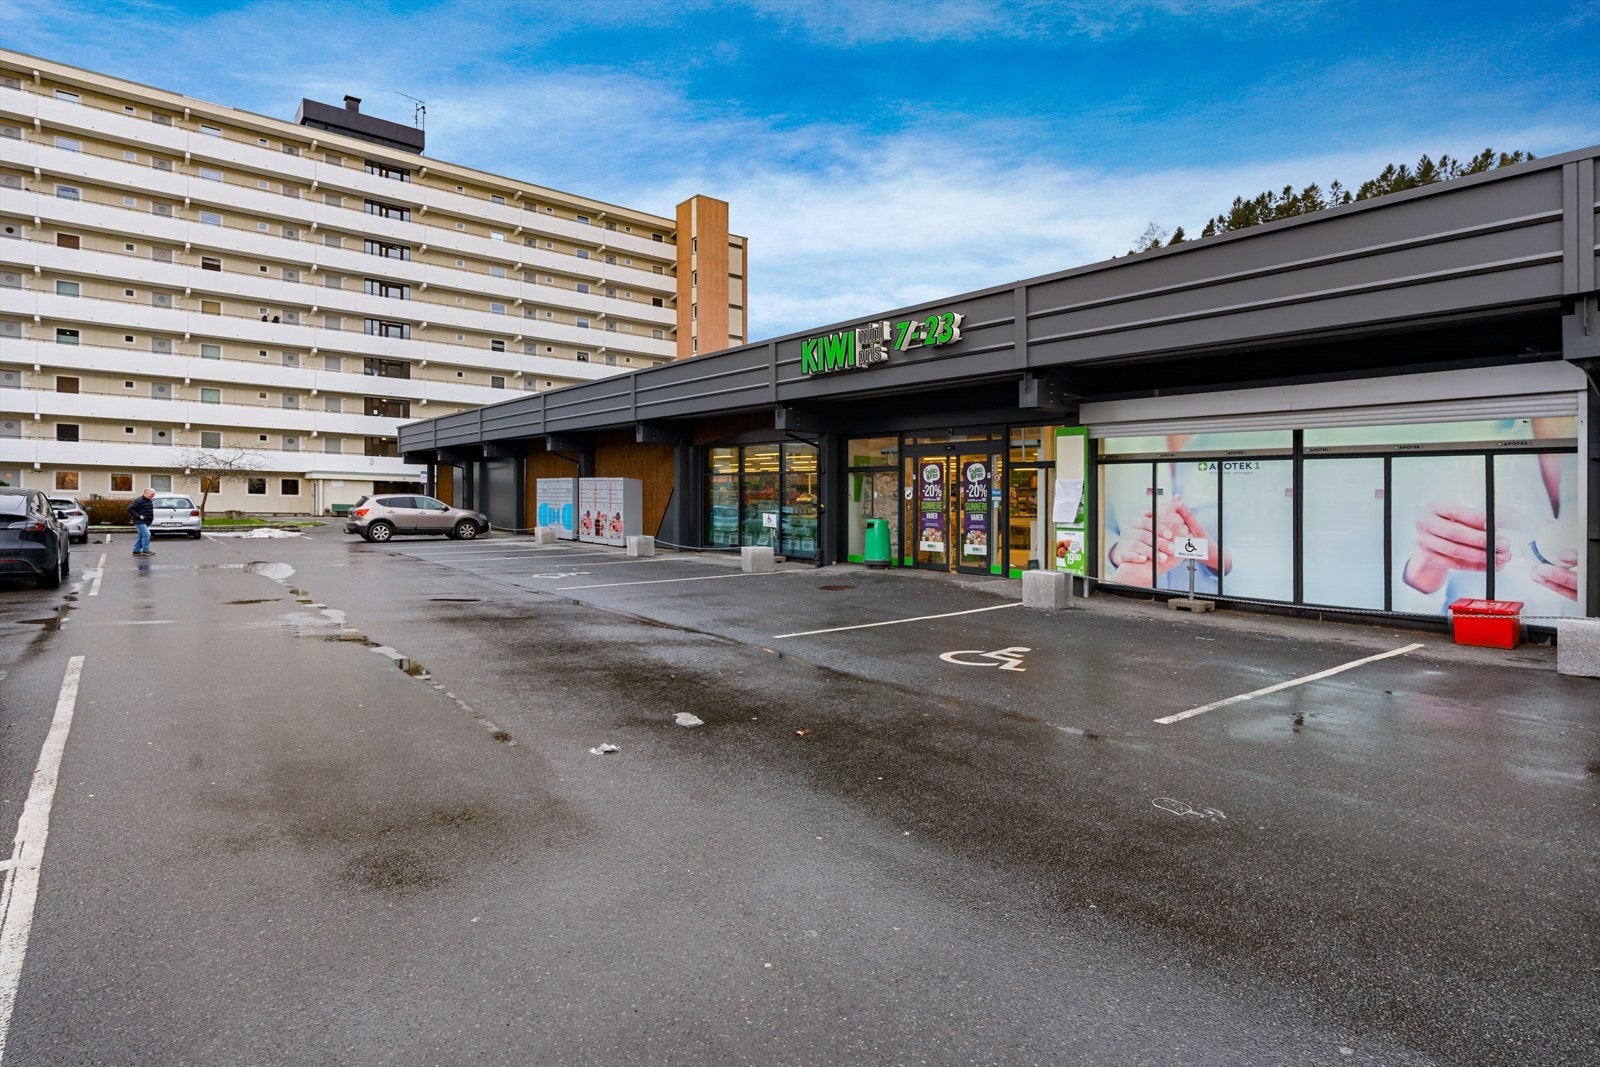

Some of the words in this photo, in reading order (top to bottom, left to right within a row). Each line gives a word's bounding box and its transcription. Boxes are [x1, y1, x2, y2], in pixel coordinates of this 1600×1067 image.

[894, 312, 956, 351] 7-23
[801, 331, 855, 374] KIWI
[858, 344, 882, 366] pris
[1209, 462, 1253, 470] AOTEK
[922, 484, 942, 497] -20%
[966, 484, 988, 498] -20%
